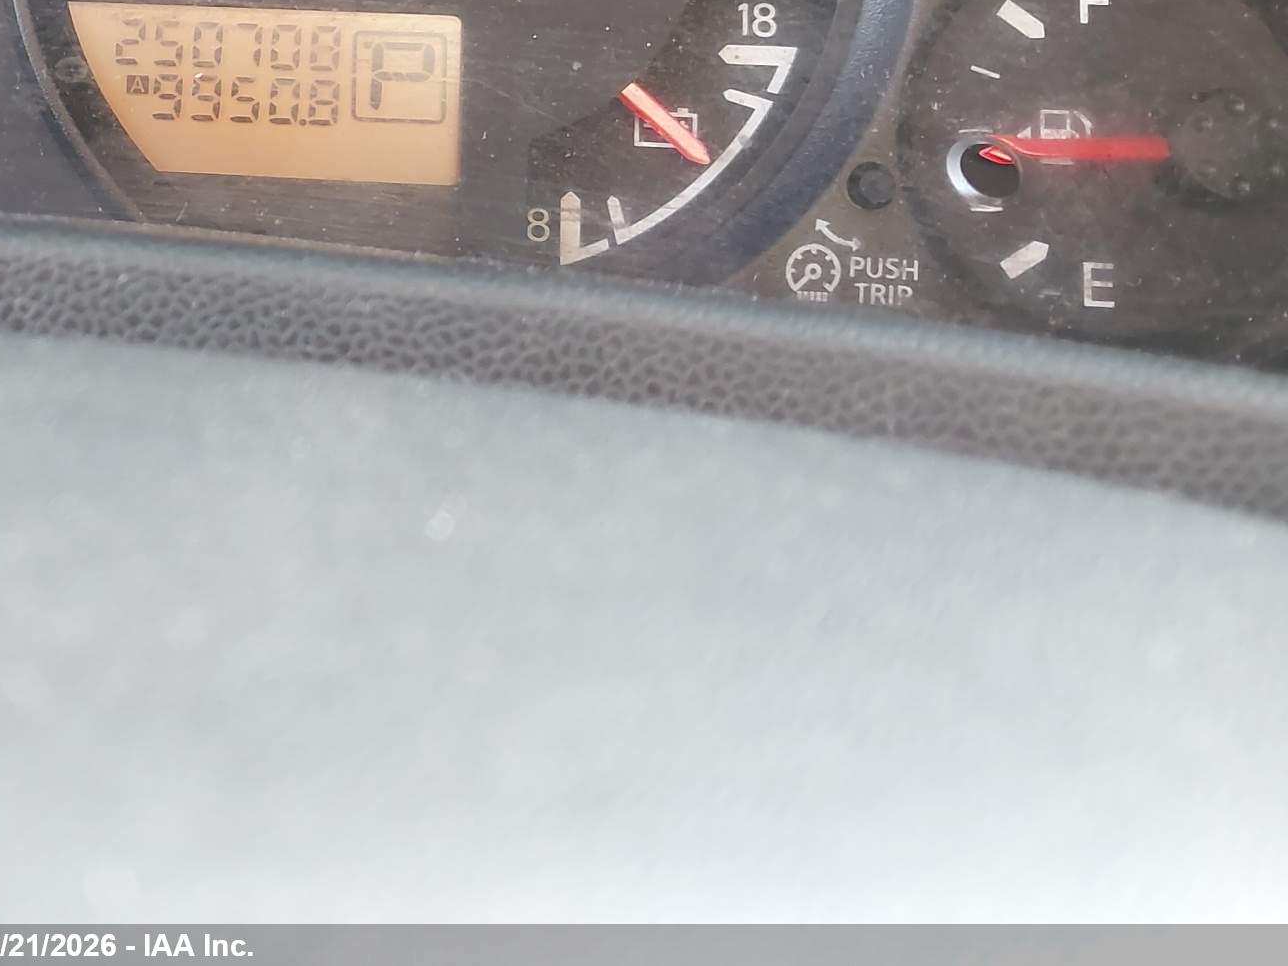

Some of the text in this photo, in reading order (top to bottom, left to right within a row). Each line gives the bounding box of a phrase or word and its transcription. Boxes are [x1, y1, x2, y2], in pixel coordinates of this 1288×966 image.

[739, 3, 776, 37] 18
[369, 40, 436, 110] P
[528, 208, 549, 241] 8
[849, 256, 920, 281] PUSH
[1083, 262, 1114, 307] E
[854, 282, 913, 305] TRIP
